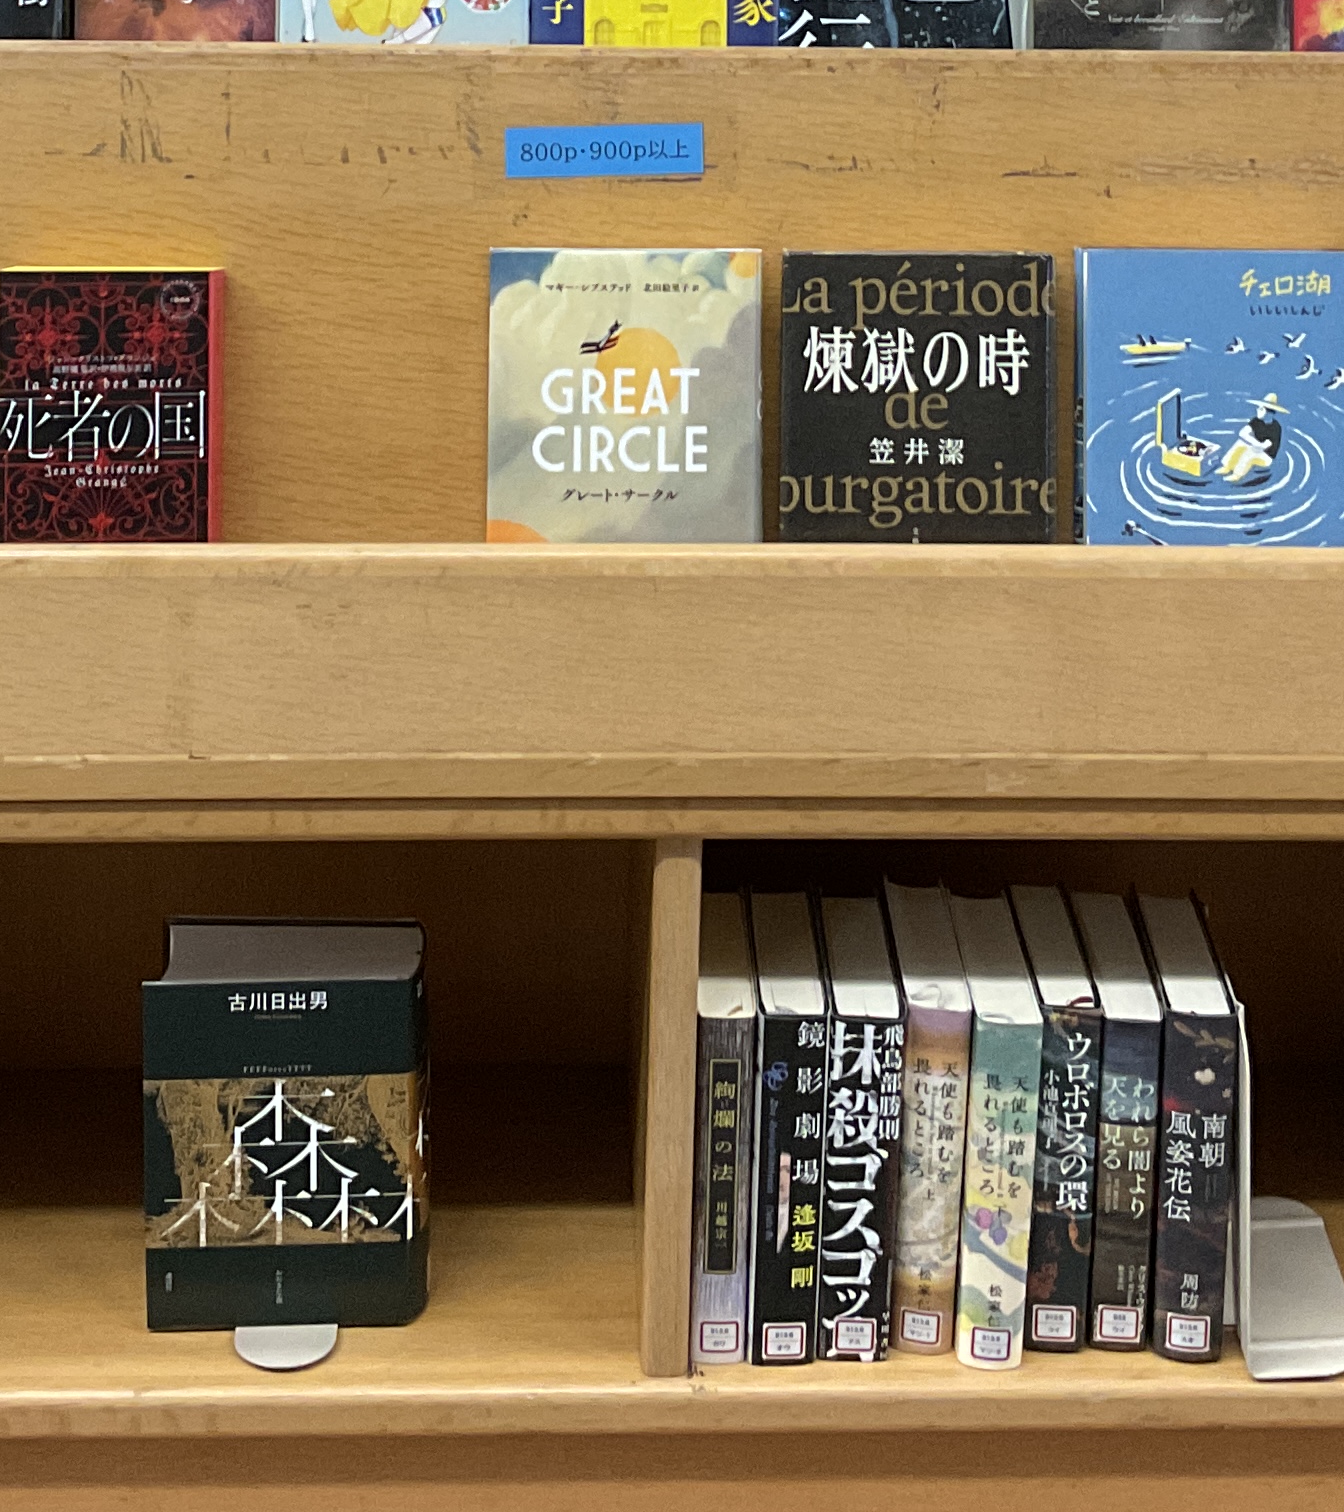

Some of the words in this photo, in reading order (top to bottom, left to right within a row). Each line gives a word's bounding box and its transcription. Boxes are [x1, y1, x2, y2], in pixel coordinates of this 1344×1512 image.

[848, 260, 1056, 331] période
[1238, 268, 1332, 298] チェロ湖
[540, 367, 701, 416] GREAT
[802, 325, 1031, 397] 煉獄の時
[531, 424, 710, 474] CIRCLE
[868, 437, 965, 465] 笠井潔
[883, 390, 950, 431] de
[227, 990, 329, 1013] 古川日出男
[712, 1080, 737, 1182] 絢爛の法
[791, 1020, 826, 1186] 鏡影劇場
[909, 1058, 933, 1179] 畏れるところ
[936, 1060, 960, 1185] 天使も踏むを
[978, 1073, 1002, 1197] 畏れるところ
[1006, 1074, 1028, 1200] 天使も踏むを
[1056, 1031, 1094, 1212] ウロボロスの環
[1101, 1076, 1127, 1171] 天を見る
[1197, 1113, 1228, 1169] 南朝
[1126, 1078, 1155, 1220] われら闇より
[1162, 1110, 1197, 1223] 風姿花伝
[790, 1204, 817, 1290] 逢坂剛
[1179, 1273, 1200, 1310] 周防
